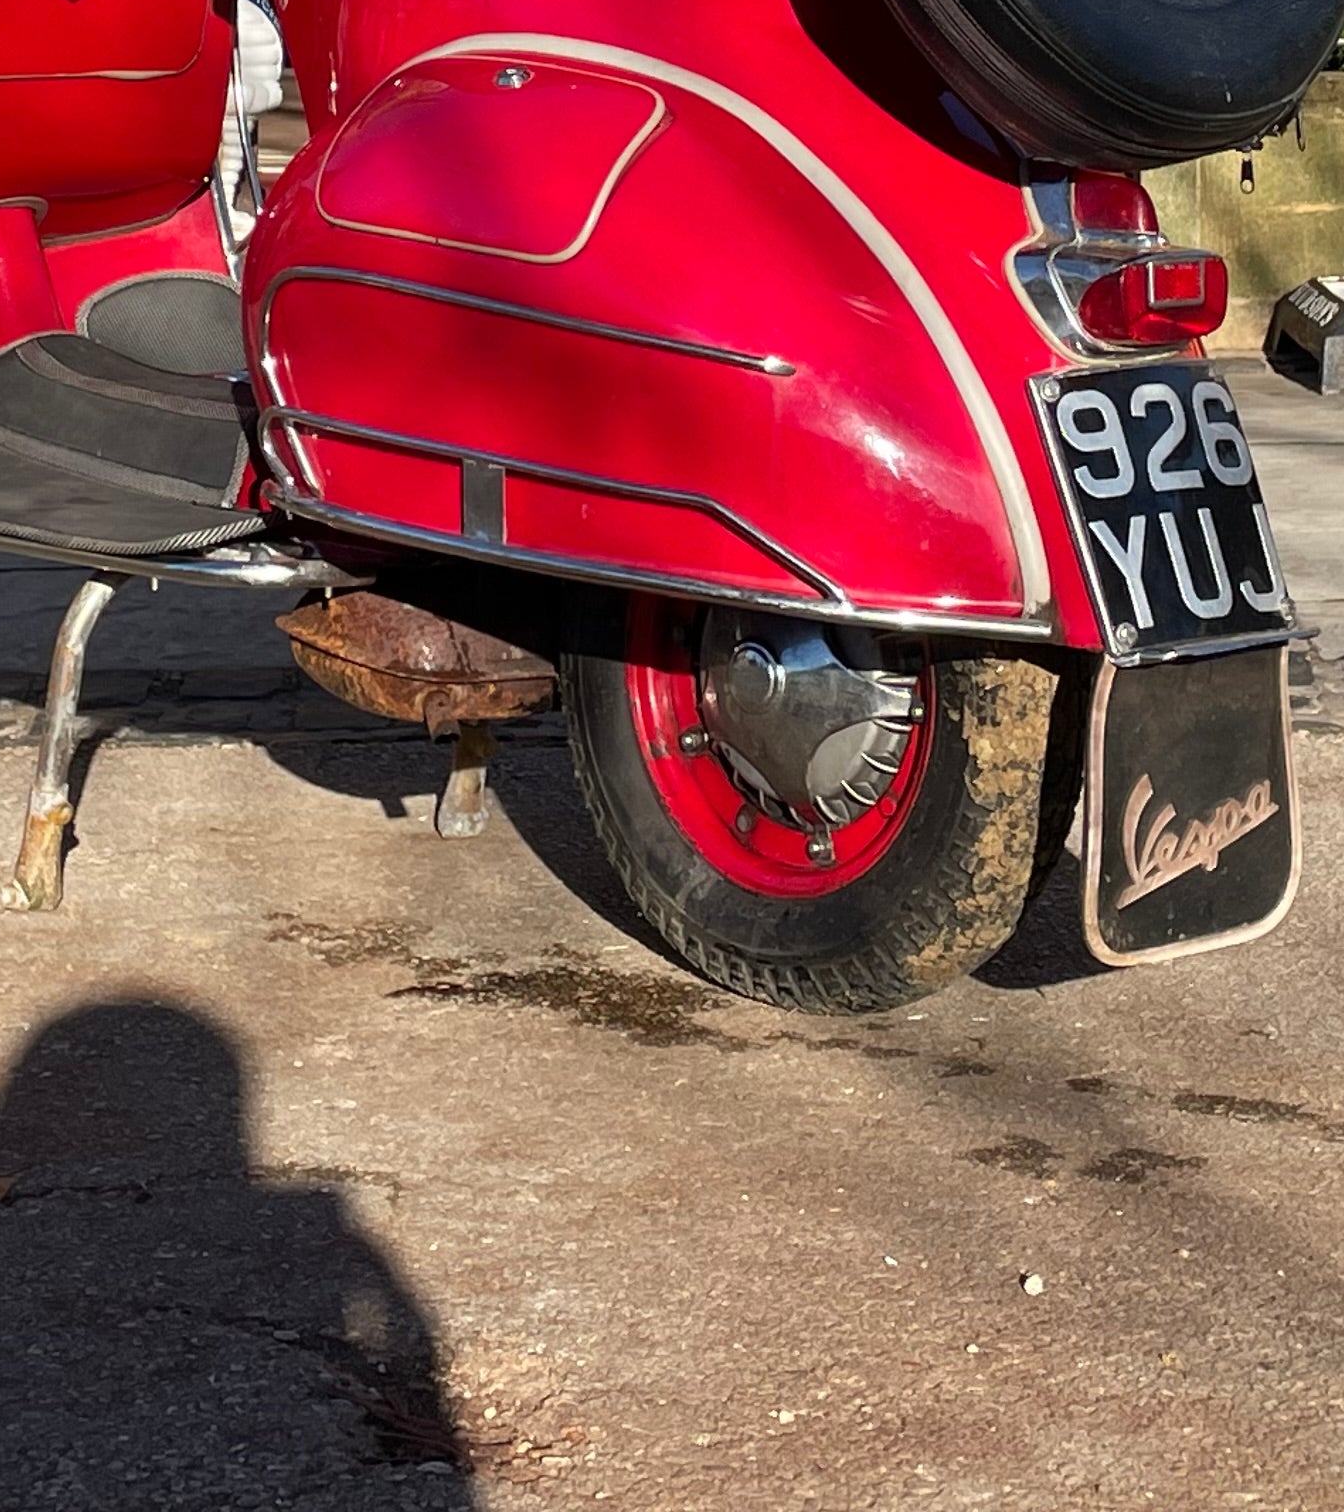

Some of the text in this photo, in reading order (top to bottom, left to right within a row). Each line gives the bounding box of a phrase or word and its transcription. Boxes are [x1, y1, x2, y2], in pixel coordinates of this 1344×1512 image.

[1055, 381, 1253, 499] 926
[1088, 502, 1288, 629] YUJ
[1117, 772, 1281, 908] Vespa
